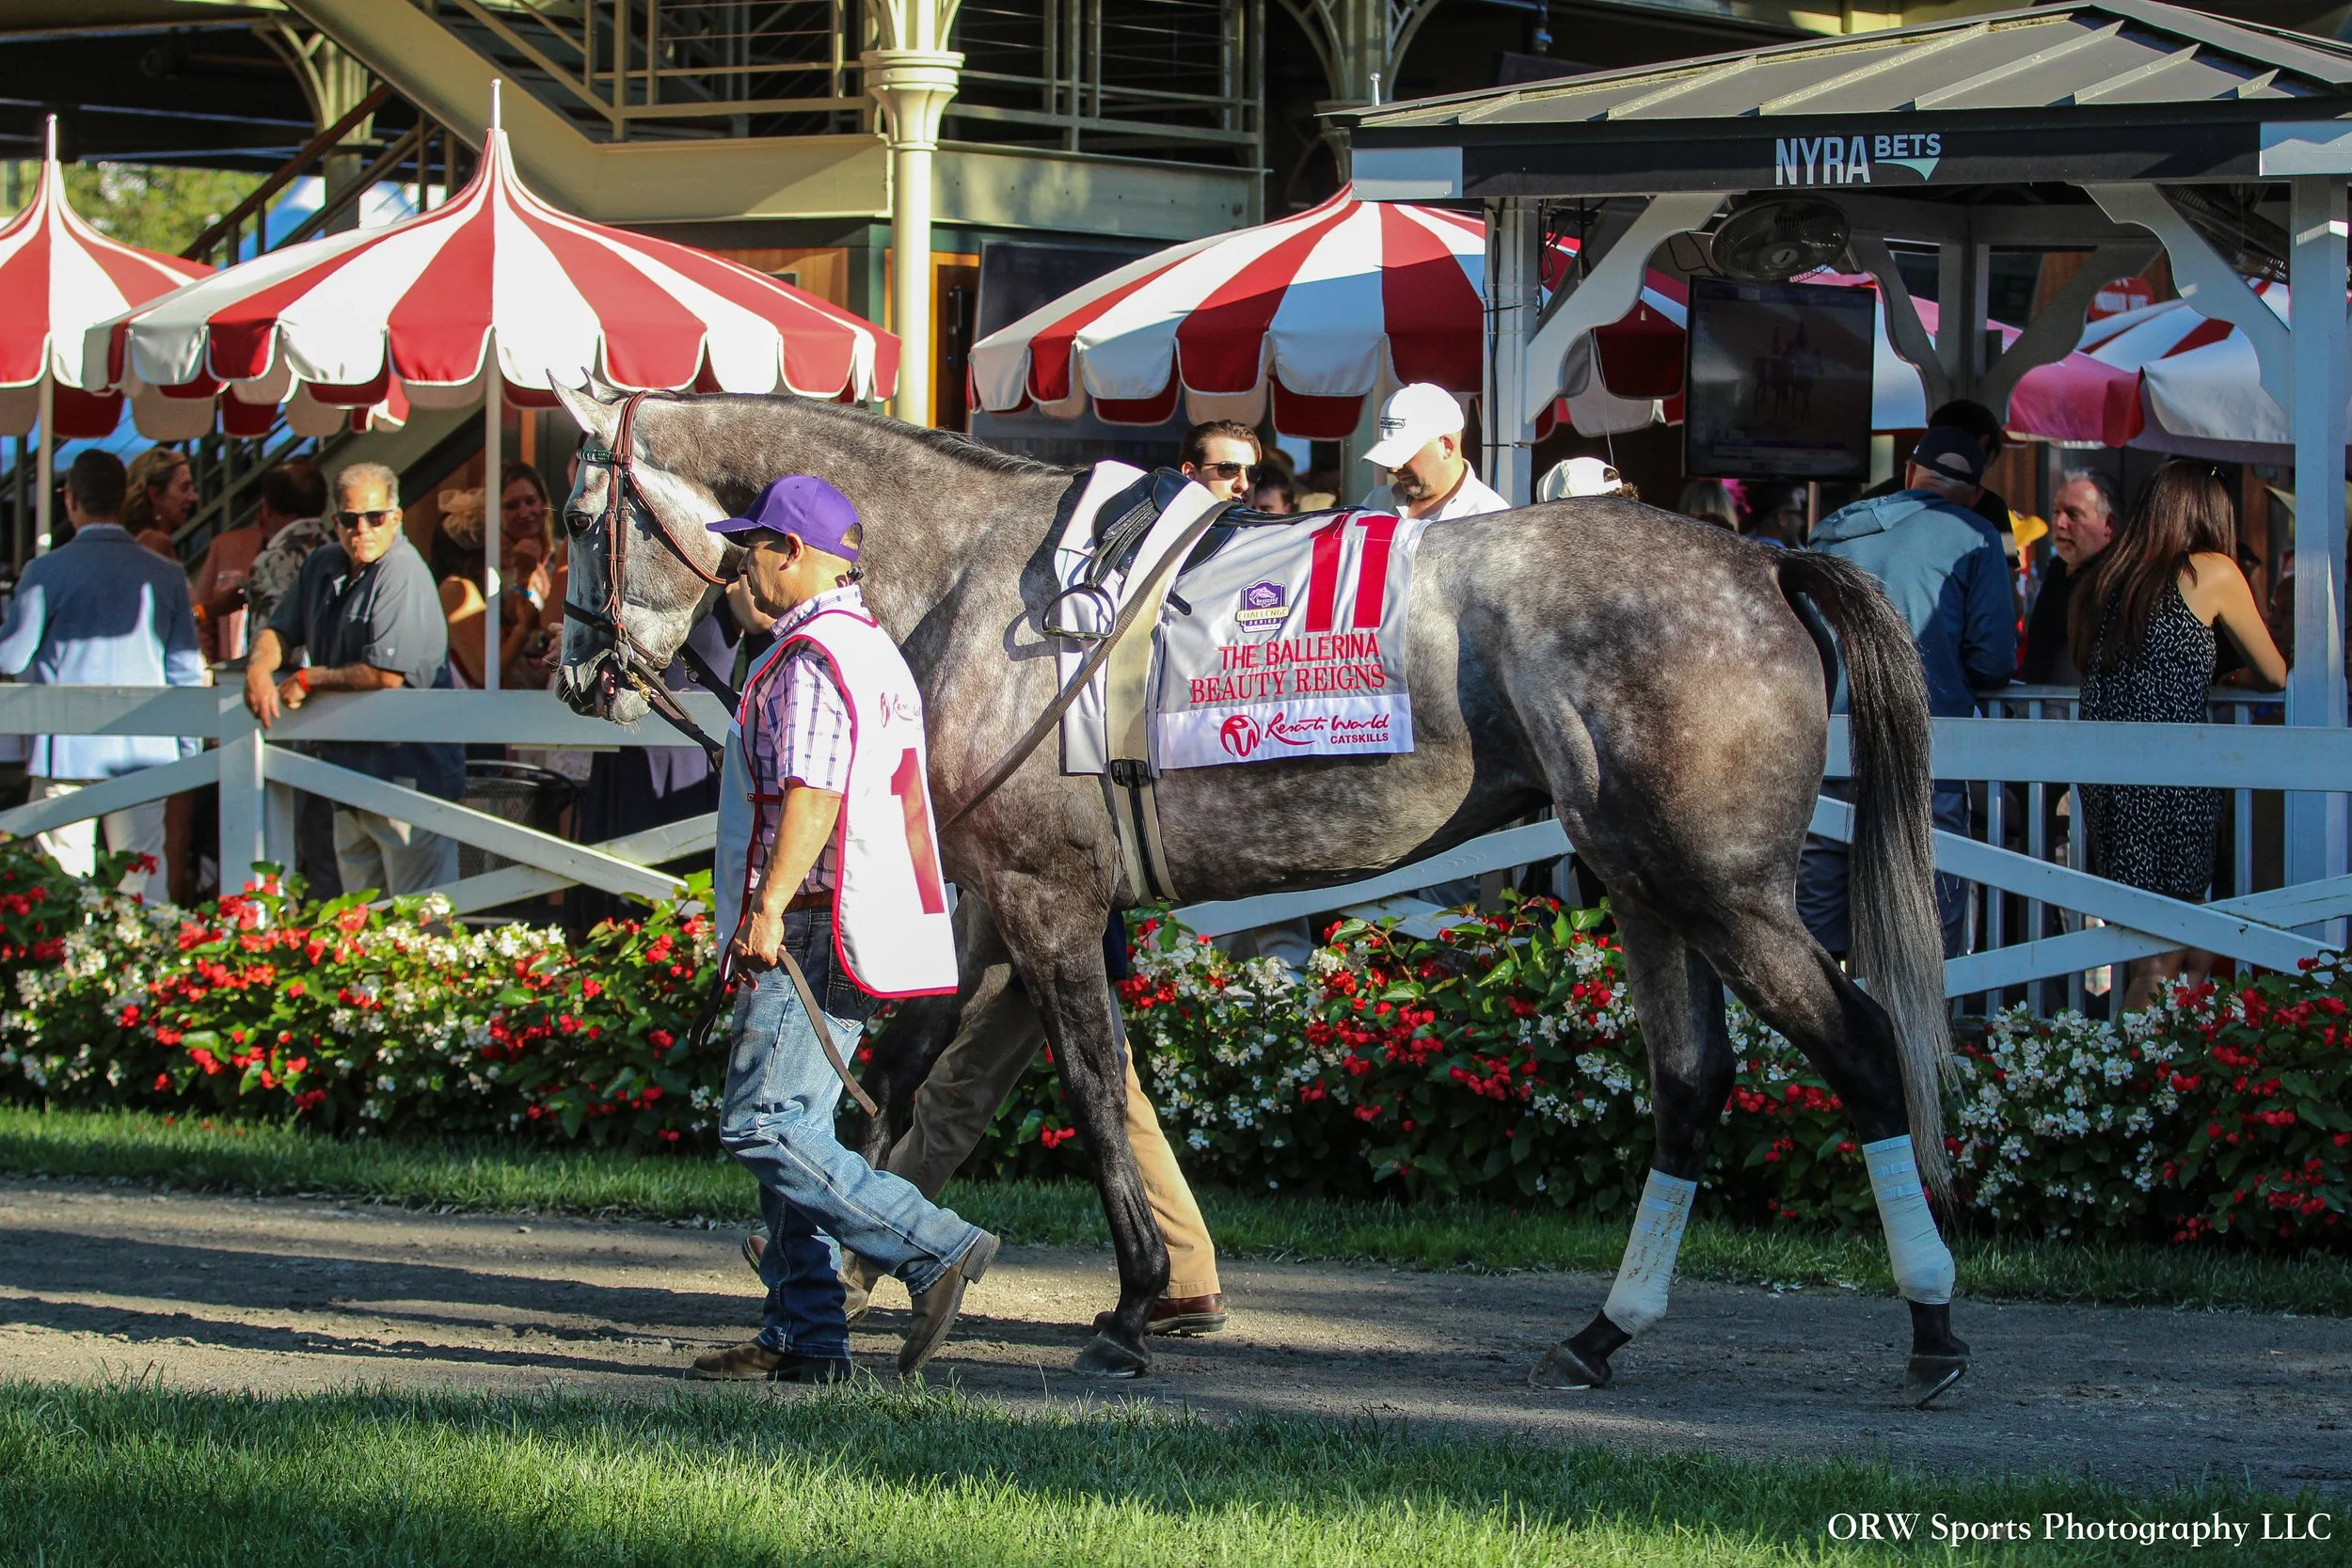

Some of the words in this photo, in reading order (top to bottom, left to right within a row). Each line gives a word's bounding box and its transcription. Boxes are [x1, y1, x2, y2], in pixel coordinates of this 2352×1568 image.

[1775, 135, 1871, 186] NYRA
[1874, 133, 1942, 158] BETS
[1305, 512, 1400, 632] 11
[1237, 608, 1288, 620] CHALLENGE
[1216, 643, 1261, 671] THE
[1265, 632, 1380, 666] BALLERINA
[1189, 668, 1288, 705] BEAUTY
[1294, 661, 1387, 694] REIGNS
[1263, 711, 1328, 747] Resorts
[1330, 713, 1391, 732] World
[1329, 732, 1390, 746] CATSKILLS
